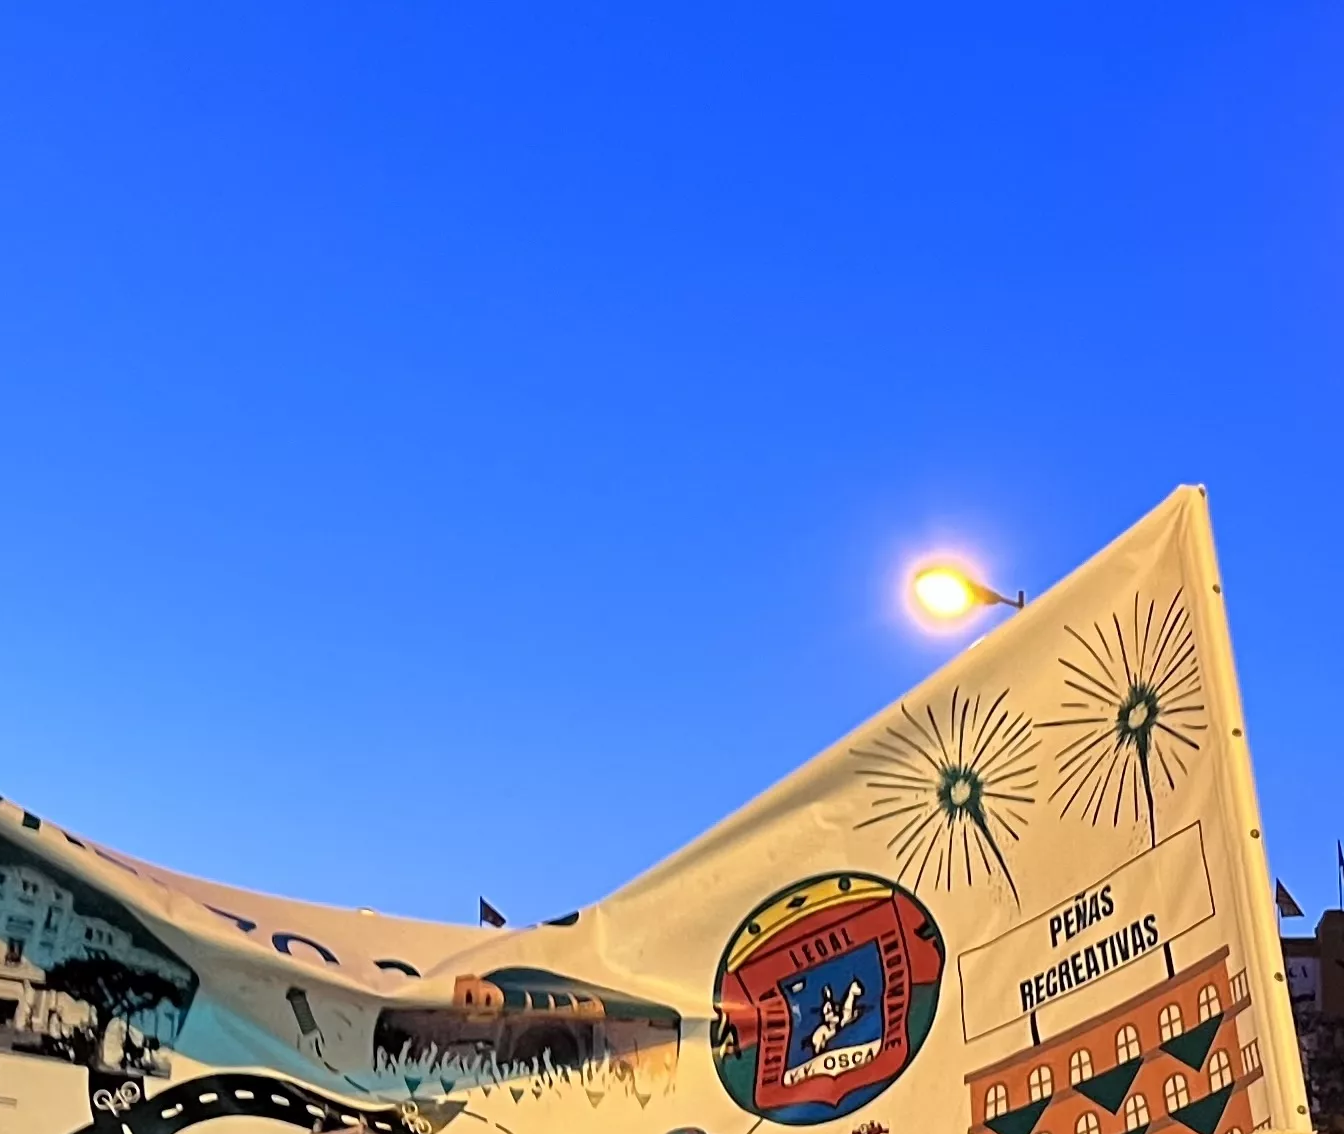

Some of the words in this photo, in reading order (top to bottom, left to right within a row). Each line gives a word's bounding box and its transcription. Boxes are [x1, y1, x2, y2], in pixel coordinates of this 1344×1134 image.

[1049, 884, 1114, 949] PEÑAS
[1019, 913, 1159, 1014] RECREATIVAS
[823, 1048, 875, 1071] OSCA
